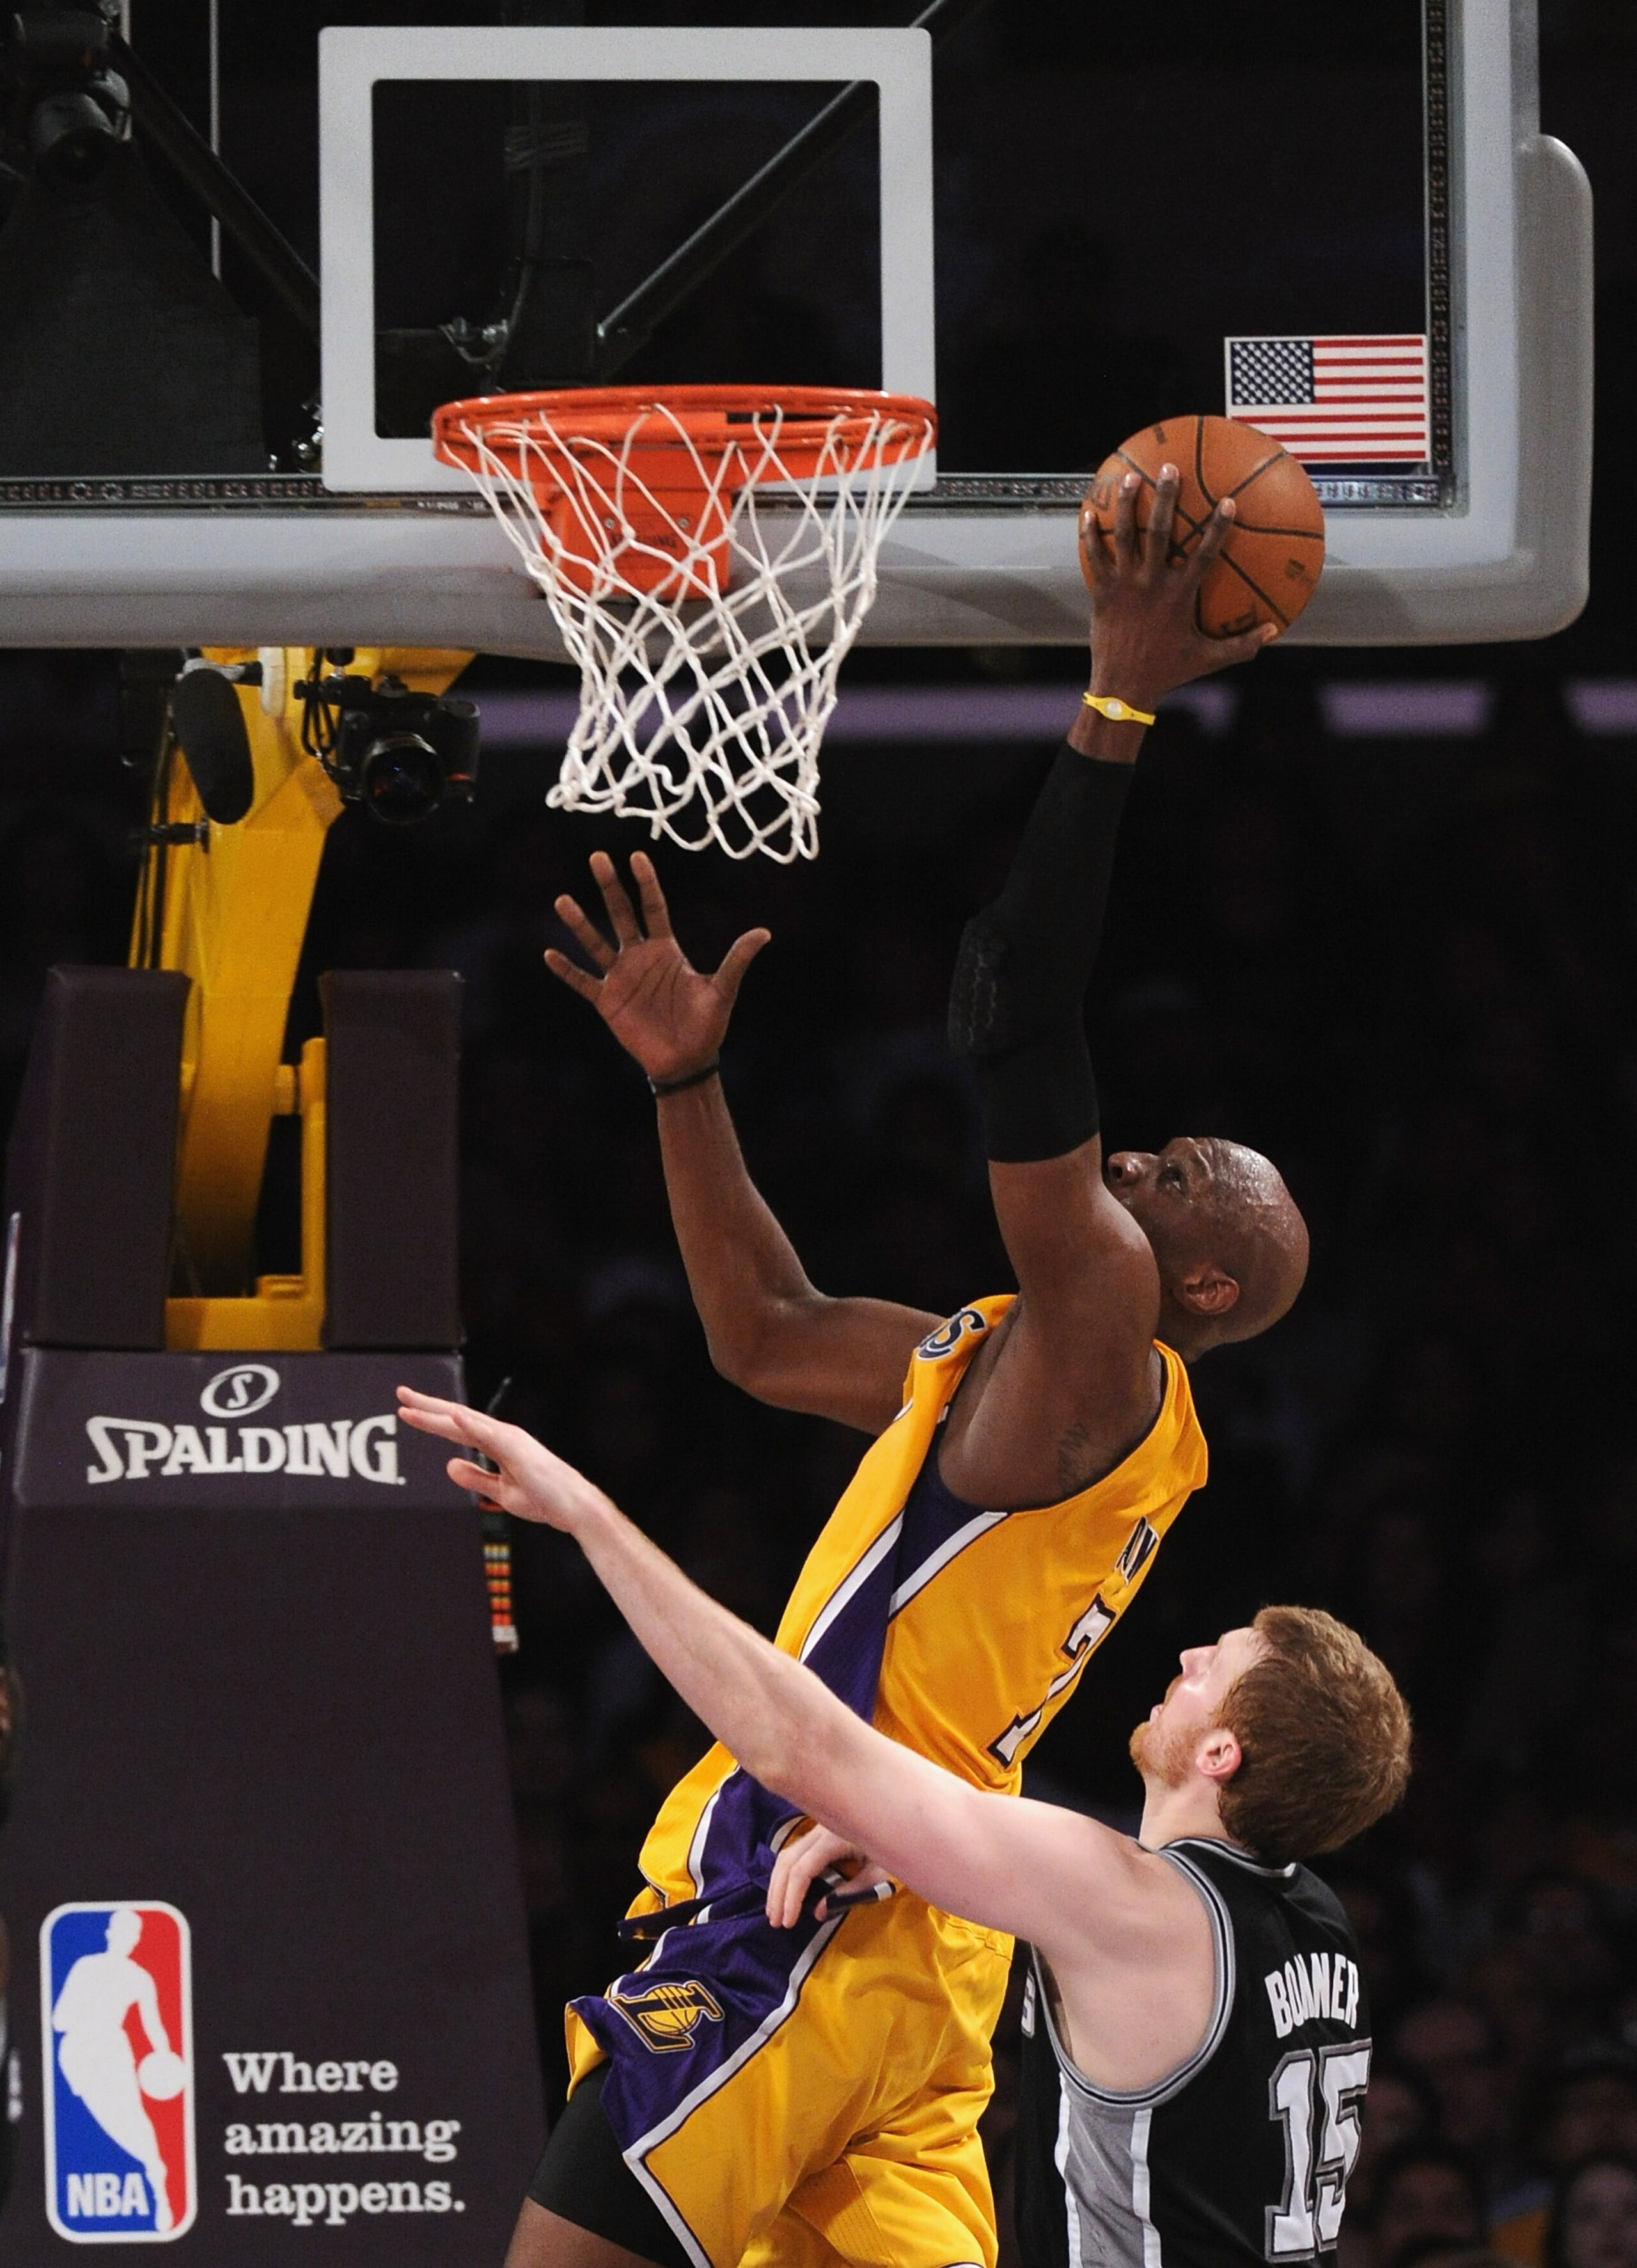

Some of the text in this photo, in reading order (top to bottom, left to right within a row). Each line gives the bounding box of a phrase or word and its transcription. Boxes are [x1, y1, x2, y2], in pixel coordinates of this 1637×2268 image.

[1264, 1952, 1359, 2038] BONNER
[222, 2051, 399, 2093] Where
[224, 2111, 462, 2163] amazing
[1264, 2036, 1373, 2263] 15
[67, 2173, 151, 2217] NBA
[225, 2173, 466, 2226] happens.
